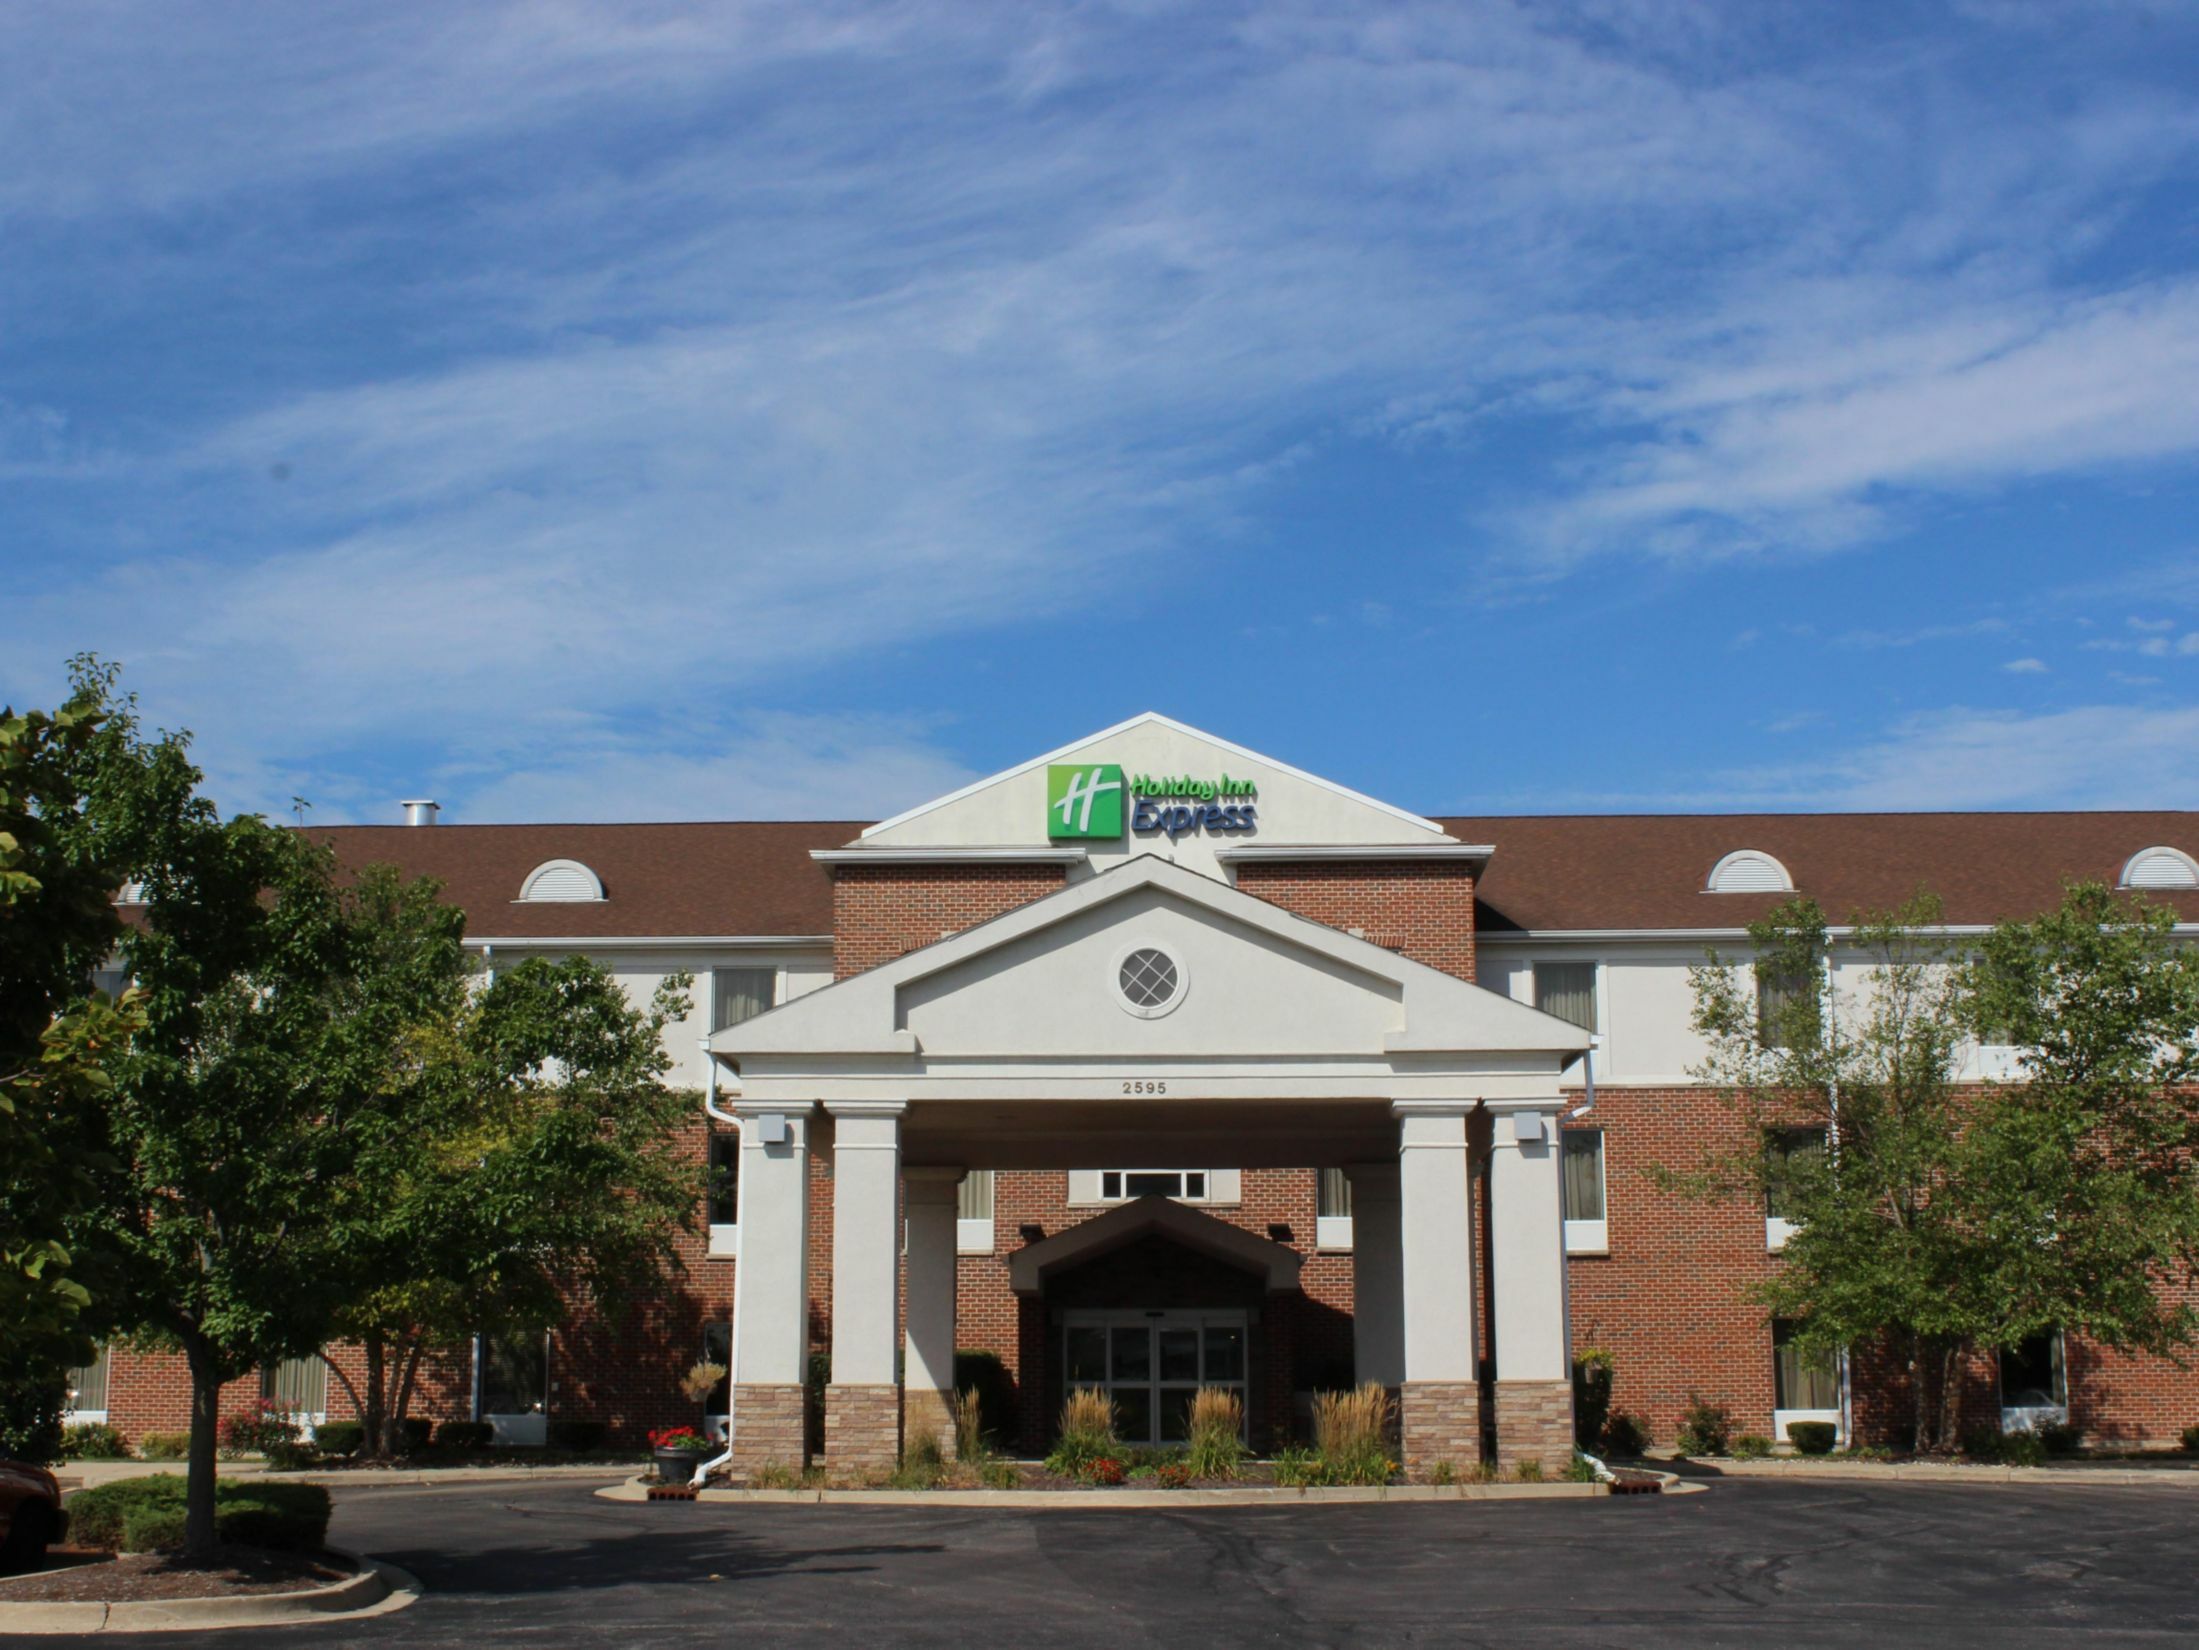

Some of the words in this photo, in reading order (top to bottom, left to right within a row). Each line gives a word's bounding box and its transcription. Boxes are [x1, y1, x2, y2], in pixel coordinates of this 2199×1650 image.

[1054, 768, 1121, 832] H
[1130, 773, 1216, 800] Holiday
[1219, 773, 1255, 796] Inn
[1130, 800, 1256, 838] Express
[1122, 1081, 1167, 1095] 2595
